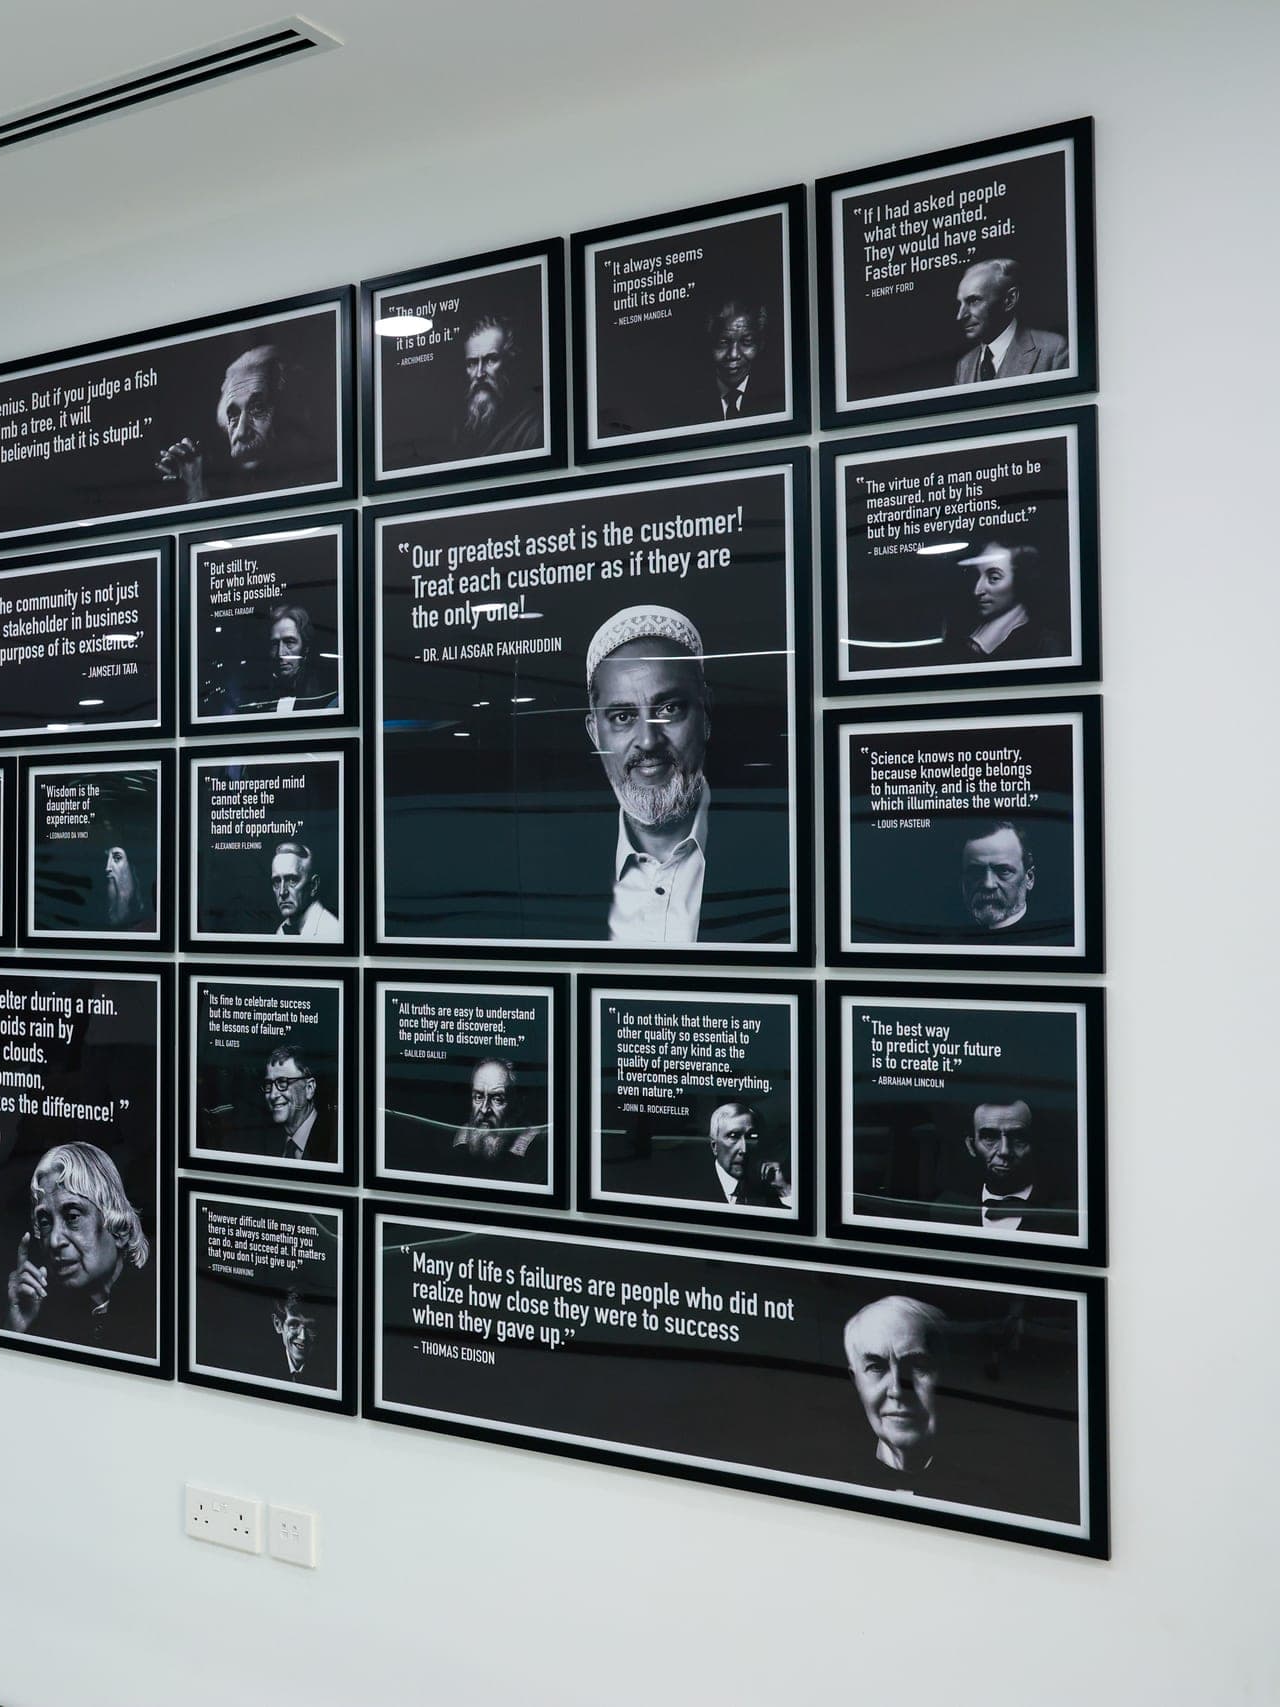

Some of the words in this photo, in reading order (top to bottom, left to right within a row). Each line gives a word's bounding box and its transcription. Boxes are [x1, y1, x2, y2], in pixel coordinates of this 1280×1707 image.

[877, 206, 881, 222] I
[885, 199, 910, 220] had
[913, 190, 955, 214] asked
[959, 181, 1006, 209] people
[863, 223, 897, 243] what
[899, 219, 929, 236] they
[863, 245, 895, 263] They
[898, 232, 940, 255] would
[944, 229, 977, 247] have
[981, 218, 1015, 239] said:
[623, 256, 662, 274] always
[665, 248, 703, 266] seems
[613, 269, 674, 294] impossible
[865, 262, 907, 282] Faster
[871, 285, 894, 298] HENRY
[895, 281, 914, 293] FORD
[613, 292, 638, 311] until
[640, 291, 656, 306] its
[618, 314, 642, 325] NELSON
[643, 309, 672, 321] MANDELA
[31, 390, 51, 410] But
[53, 388, 62, 406] if
[63, 387, 85, 409] you
[87, 378, 121, 403] judge
[124, 377, 132, 392] a
[134, 369, 158, 389] fish
[867, 505, 941, 526] extraordinary
[867, 525, 885, 539] but
[887, 523, 901, 540] by
[903, 520, 921, 535] his
[923, 515, 975, 534] everyday
[447, 535, 521, 571] greatest
[525, 528, 576, 556] asset
[581, 525, 598, 550] is
[602, 522, 634, 547] the
[640, 507, 743, 542] customer!
[226, 559, 243, 574] still
[244, 559, 259, 575] try.
[411, 573, 455, 599] Treat
[459, 567, 501, 594] each
[507, 562, 595, 589] customer
[600, 559, 623, 579] as
[629, 551, 643, 577] if
[647, 549, 691, 578] they
[697, 548, 731, 570] are
[210, 576, 225, 590] For
[226, 574, 245, 588] who
[246, 572, 276, 585] knows
[210, 590, 232, 604] what
[233, 588, 241, 602] is
[3, 615, 69, 638] stakeholder
[71, 612, 82, 630] in
[85, 609, 139, 629] business
[423, 647, 440, 662] DR.
[441, 646, 458, 661] ALI
[460, 643, 494, 659] ASGAR
[496, 637, 562, 656] FAKHRUDDIN
[87, 664, 121, 678] JAMSETJI
[122, 662, 138, 675] TATA
[917, 750, 955, 764] knows
[957, 751, 972, 762] no
[78, 784, 86, 797] is
[87, 783, 100, 796] the
[228, 776, 280, 794] unprepared
[282, 774, 305, 789] mind
[46, 799, 81, 814] daughter
[82, 798, 90, 810] of
[211, 792, 241, 806] cannot
[242, 794, 258, 805] see
[260, 791, 275, 805] the
[870, 797, 904, 811] which
[907, 796, 969, 810] illuminates
[971, 795, 991, 809] the
[211, 807, 266, 820] outstretched
[877, 819, 898, 829] LOUIS
[899, 818, 931, 828] PASTEUR
[210, 821, 233, 835] hand
[234, 821, 244, 834] of
[30, 991, 72, 1019] during
[75, 998, 84, 1014] a
[87, 994, 118, 1016] rain.
[411, 1004, 436, 1016] truths
[437, 1007, 452, 1017] are
[453, 1007, 474, 1021] easy
[475, 1006, 484, 1018] to
[486, 1007, 536, 1020] understand
[208, 1020, 221, 1032] the
[221, 1021, 250, 1034] lessons
[250, 1023, 259, 1034] of
[896, 1021, 922, 1037] best
[924, 1026, 950, 1041] way
[871, 1037, 883, 1052] to
[886, 1039, 930, 1056] predict
[932, 1043, 961, 1059] your
[963, 1042, 1002, 1057] future
[872, 1054, 883, 1069] is
[885, 1054, 897, 1070] to
[900, 1057, 939, 1071] create
[617, 1068, 624, 1081] It
[626, 1072, 679, 1084] overcomes
[680, 1072, 714, 1087] almost
[878, 1076, 913, 1086] ABRAHAM
[913, 1078, 945, 1088] LINCOLN
[18, 1093, 39, 1115] the
[42, 1095, 114, 1122] difference!
[413, 1280, 464, 1304] realize
[468, 1284, 502, 1309] how
[506, 1290, 549, 1316] close
[553, 1296, 590, 1327] they
[594, 1306, 637, 1328] were
[641, 1308, 659, 1331] to
[664, 1316, 739, 1342] success
[412, 1305, 454, 1329] when
[458, 1310, 492, 1339] they
[496, 1320, 535, 1342] gave
[421, 1340, 459, 1359] THOMAS
[461, 1347, 495, 1365] EDISON
